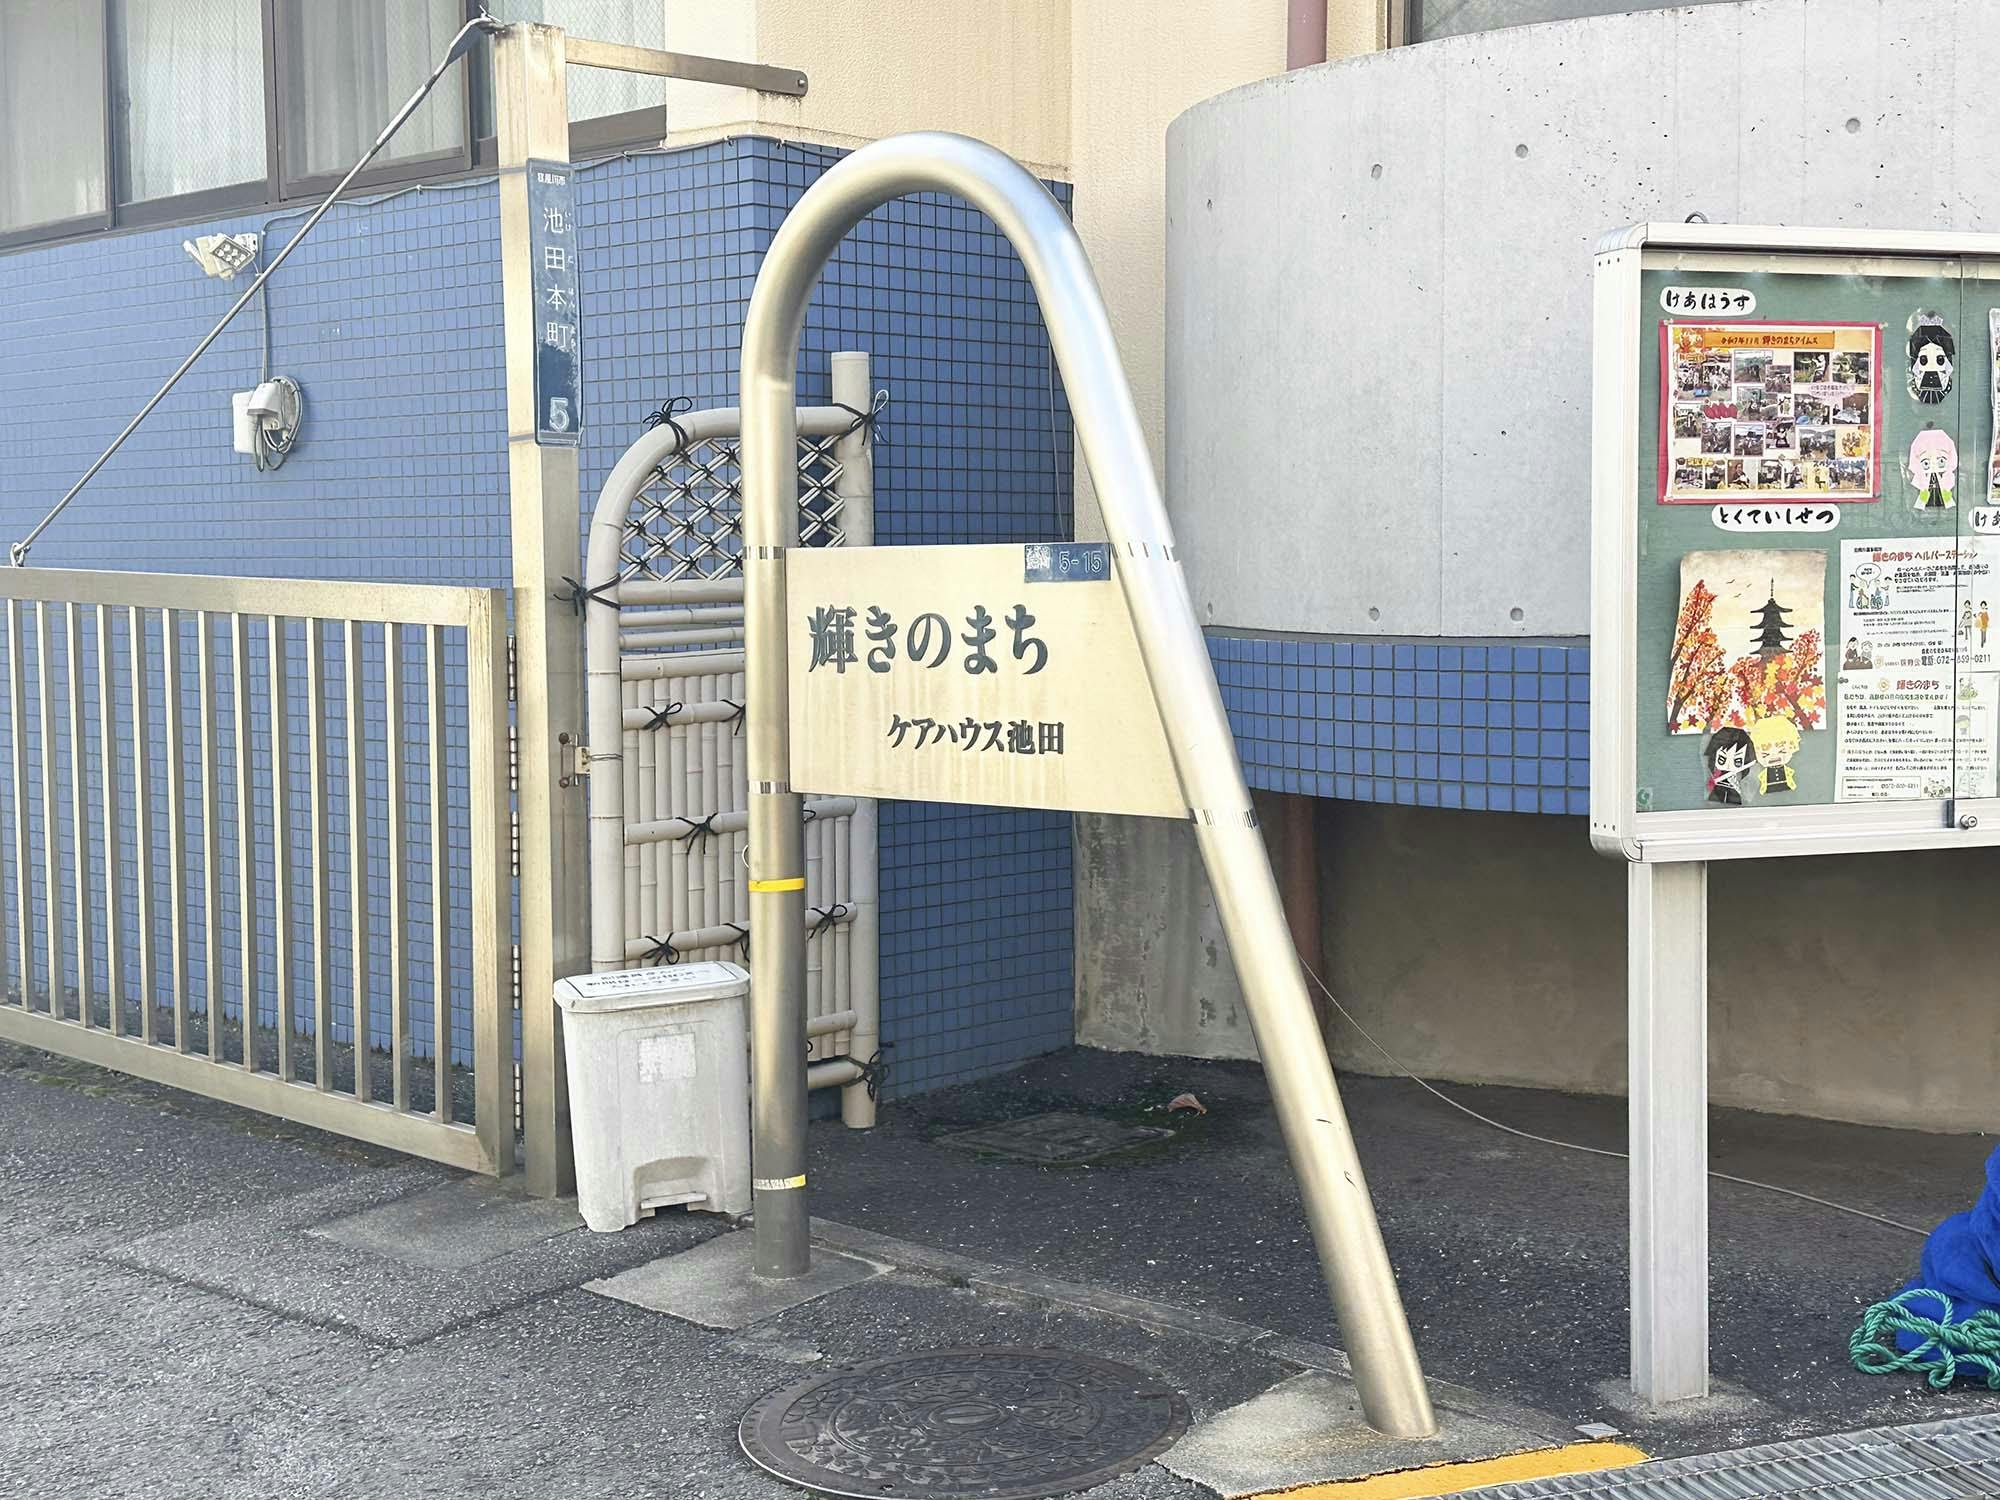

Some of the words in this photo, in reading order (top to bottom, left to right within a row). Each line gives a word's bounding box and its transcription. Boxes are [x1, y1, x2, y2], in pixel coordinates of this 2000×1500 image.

[543, 207, 569, 351] 池田本町
[1665, 289, 1750, 312] けあはうす
[549, 396, 570, 433] 5
[1719, 507, 1835, 525] とくていしせつ
[1058, 550, 1103, 573] 5-15
[807, 603, 1049, 675] 輝きのまち
[887, 713, 1065, 755] ケアハウス池田
